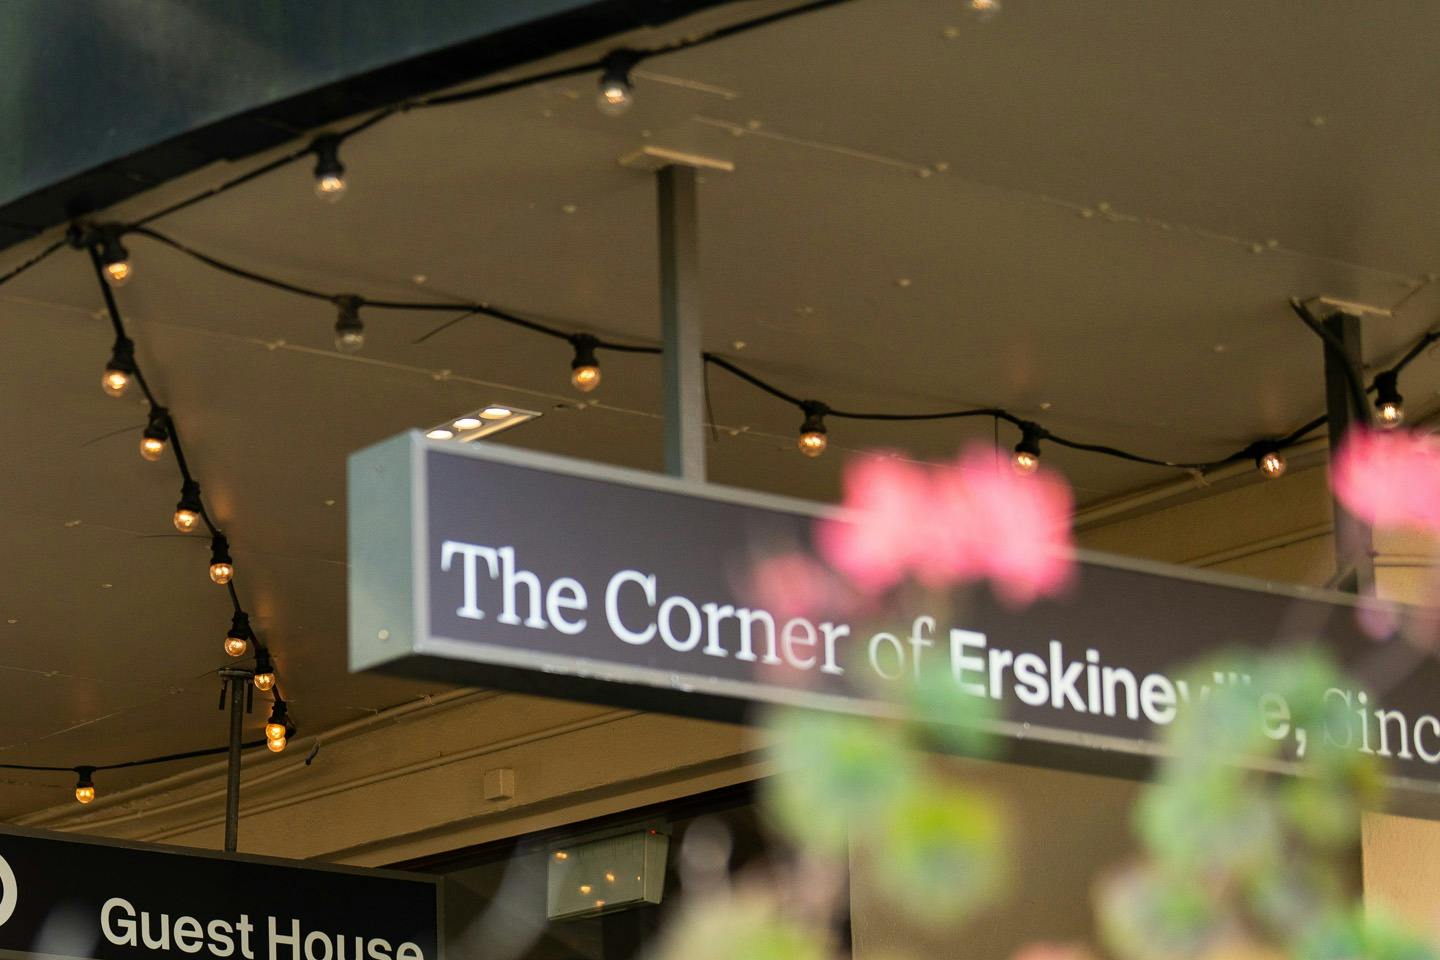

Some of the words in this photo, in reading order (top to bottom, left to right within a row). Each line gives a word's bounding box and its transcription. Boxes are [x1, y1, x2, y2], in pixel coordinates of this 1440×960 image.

[440, 539, 589, 636] The
[604, 568, 851, 676] Corner
[867, 614, 938, 685] of
[948, 627, 1308, 757] Erskinee,
[99, 897, 255, 960] Guest
